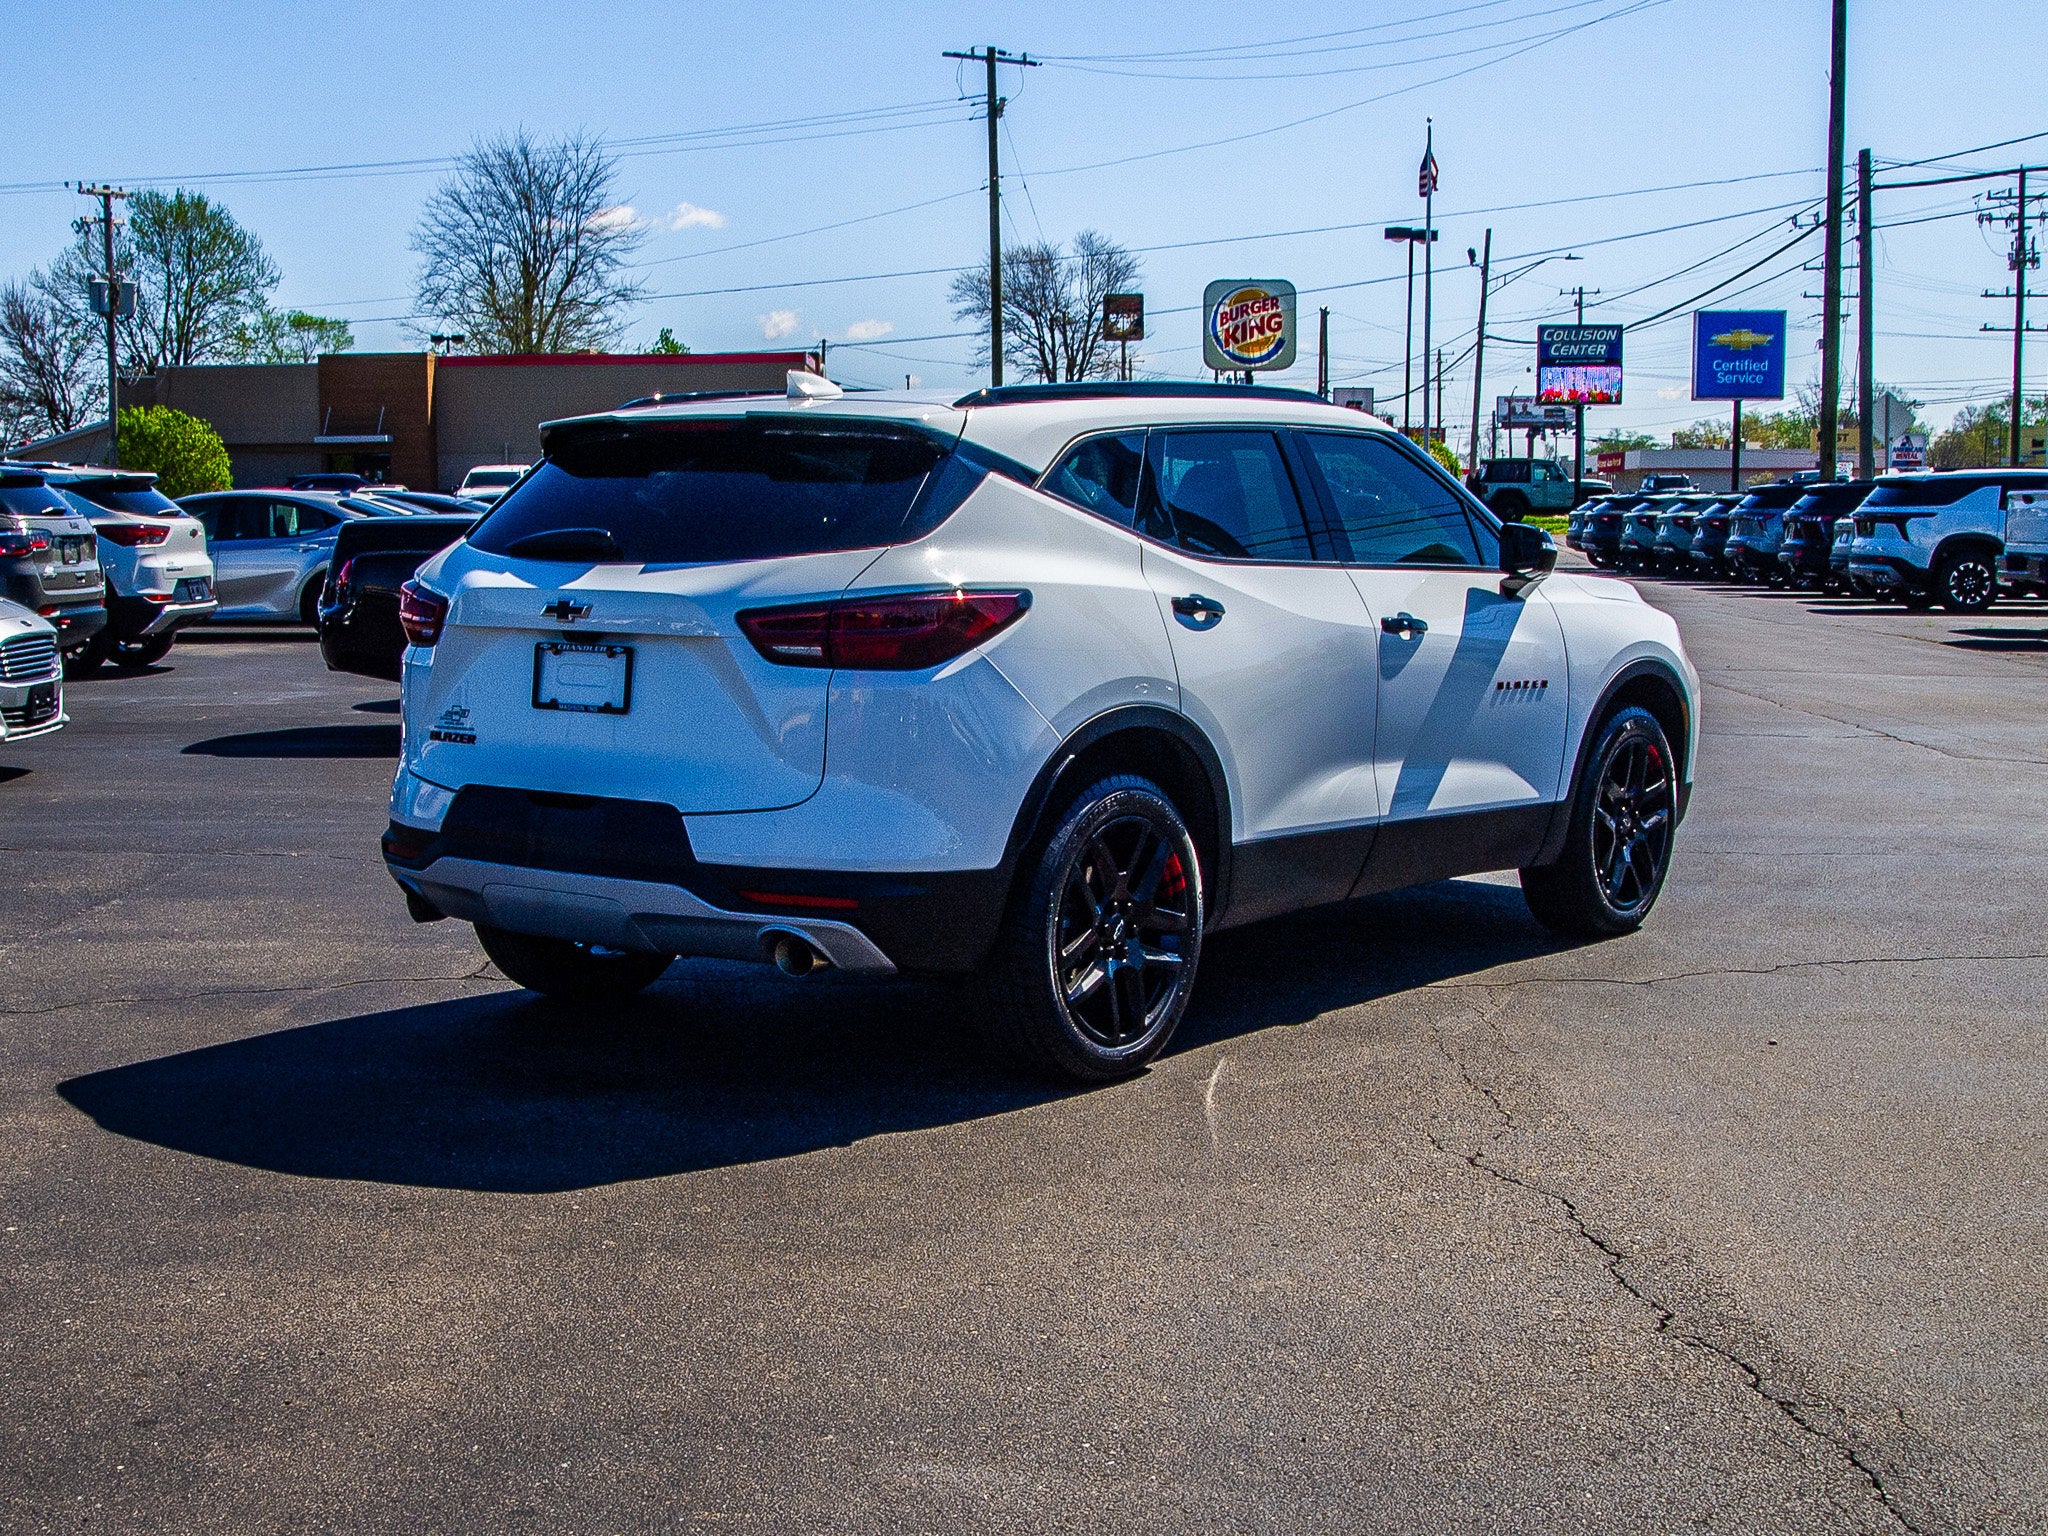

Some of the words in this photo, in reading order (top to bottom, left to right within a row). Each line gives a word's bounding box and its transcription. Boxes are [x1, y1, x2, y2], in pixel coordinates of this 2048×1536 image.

[1219, 297, 1280, 327] BURGER
[1223, 312, 1283, 349] KING
[1543, 329, 1618, 342] COLLISION
[1550, 343, 1607, 356] CENTER
[1713, 359, 1769, 371] Certified
[1717, 371, 1764, 384] Service
[556, 643, 608, 653] CHANDLER
[1496, 680, 1548, 690] BLAZER
[429, 730, 477, 745] BLAZER
